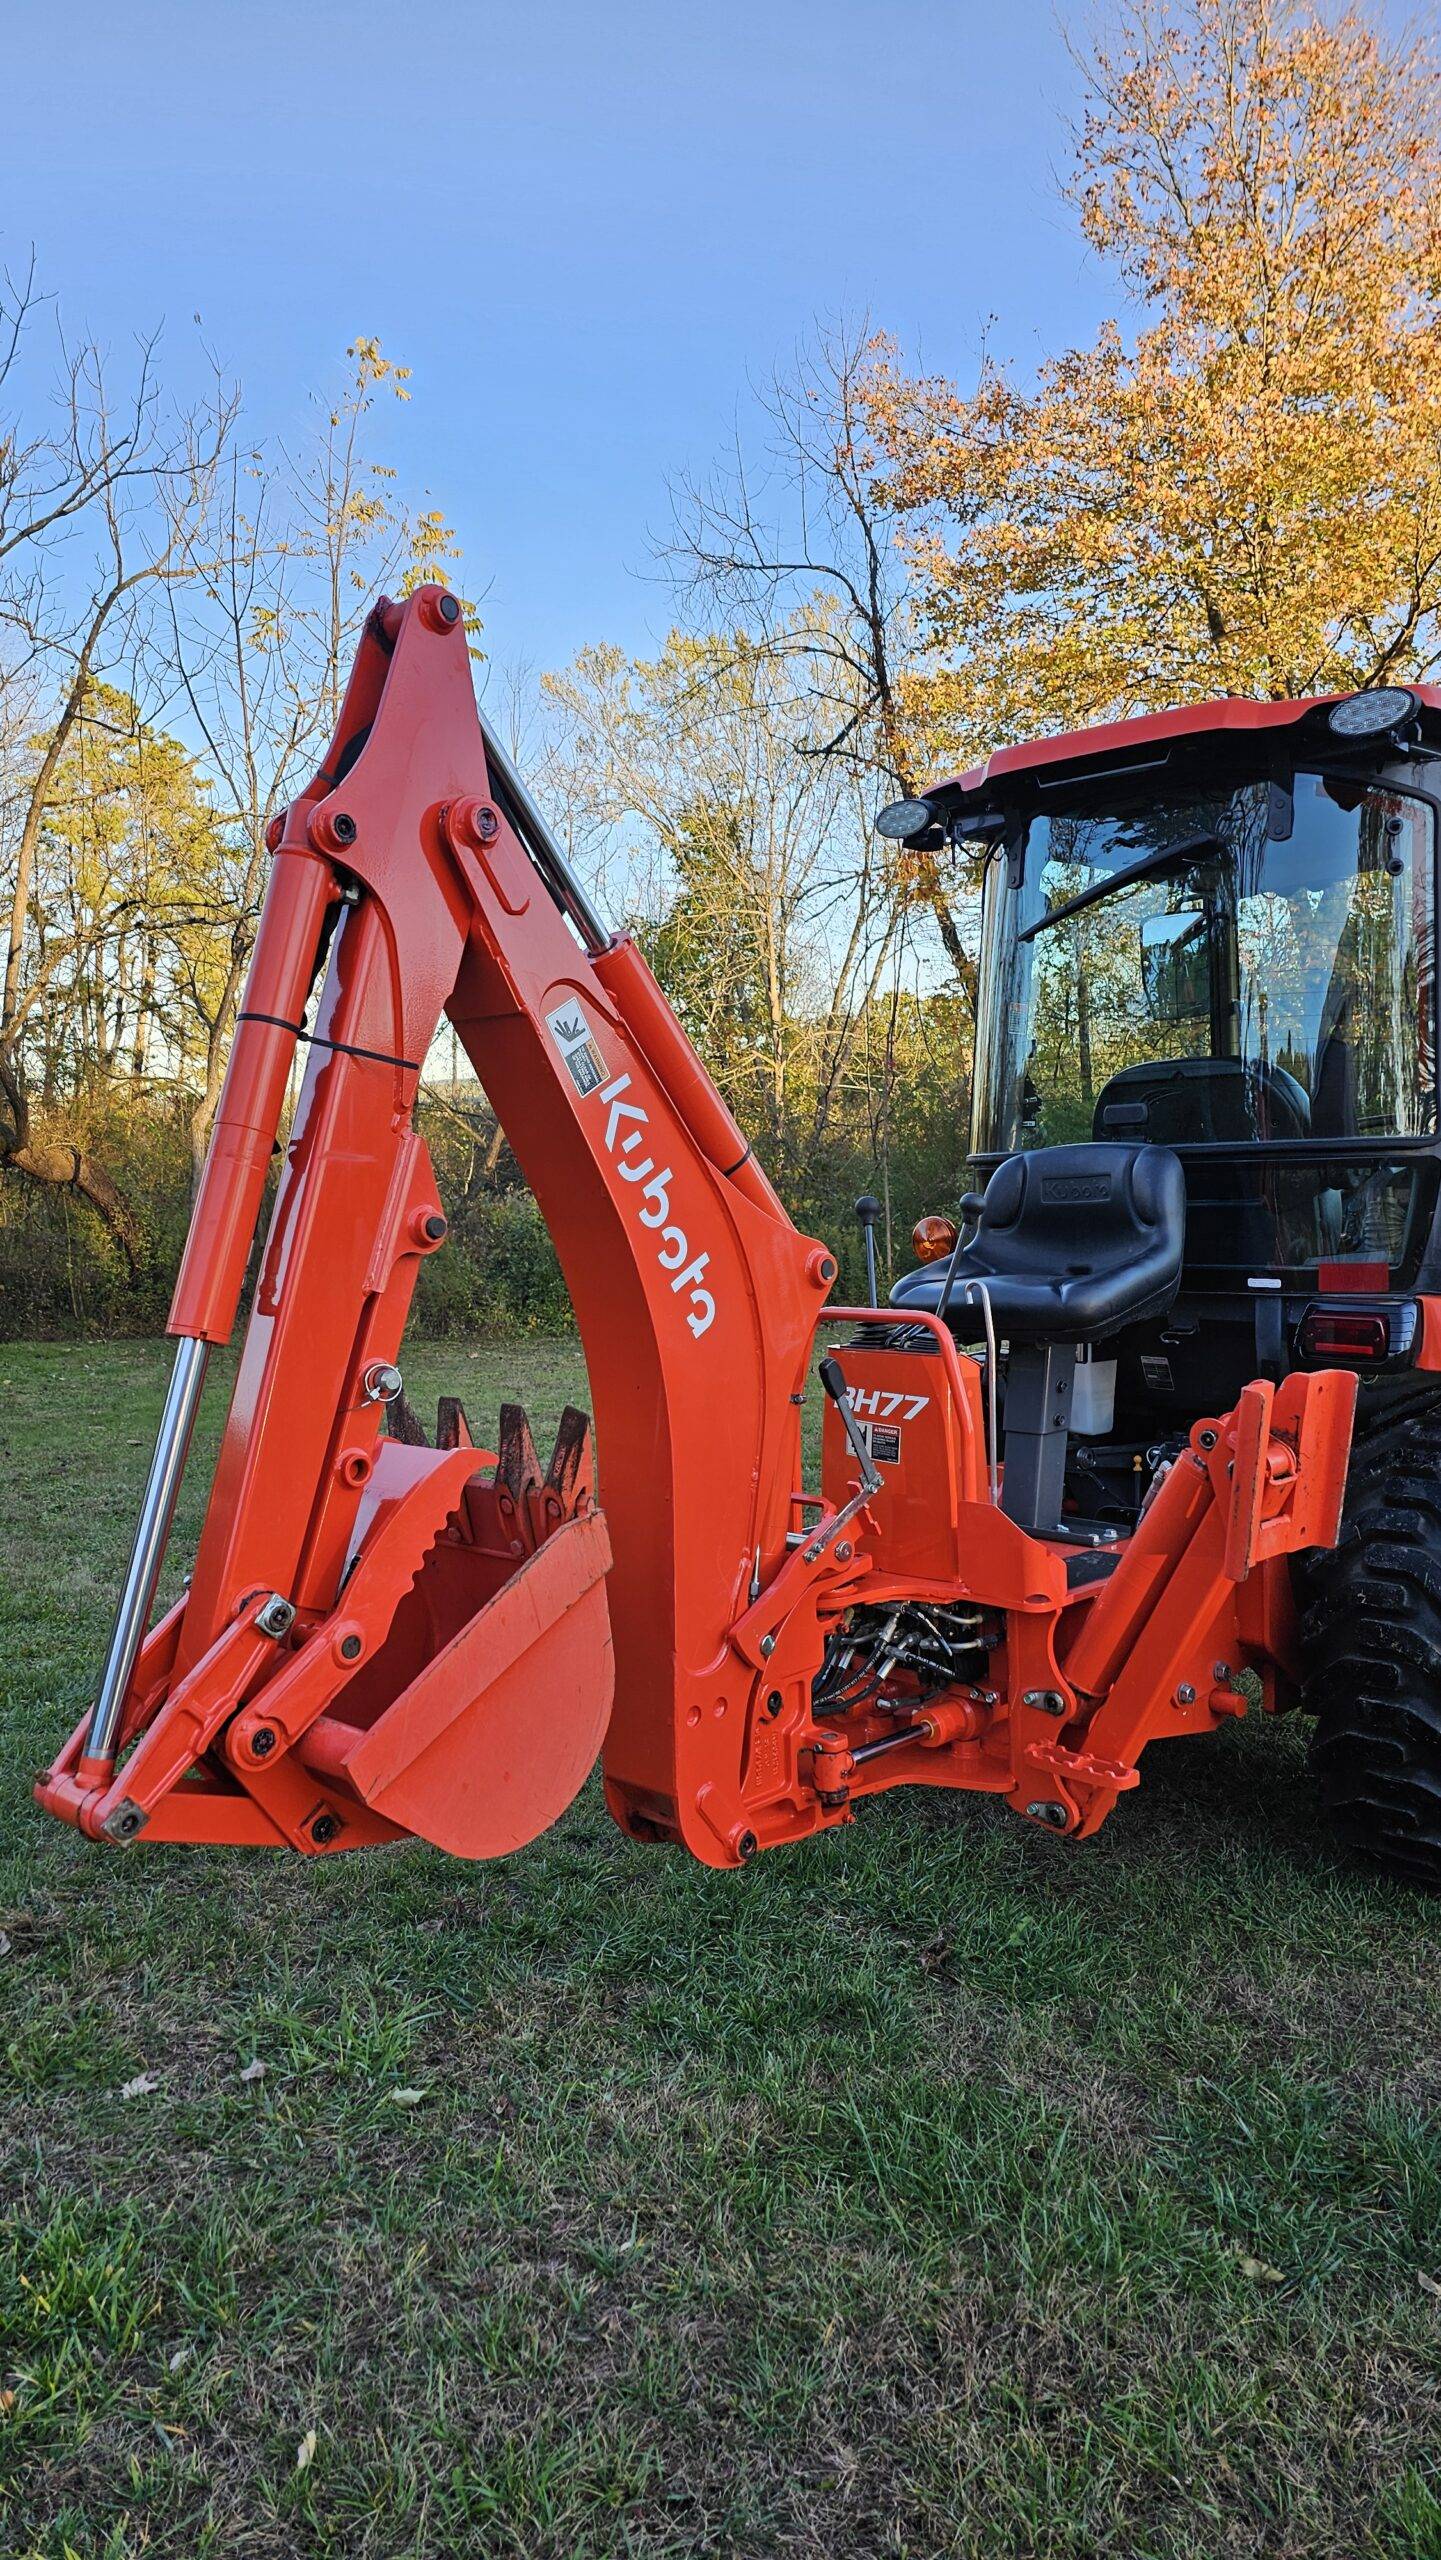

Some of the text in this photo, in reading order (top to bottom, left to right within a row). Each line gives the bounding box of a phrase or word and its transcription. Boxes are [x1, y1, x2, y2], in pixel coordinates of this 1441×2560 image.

[1044, 1178, 1109, 1199] Kubota
[599, 1073, 716, 1339] Kubota
[878, 1427, 898, 1435] DANGER
